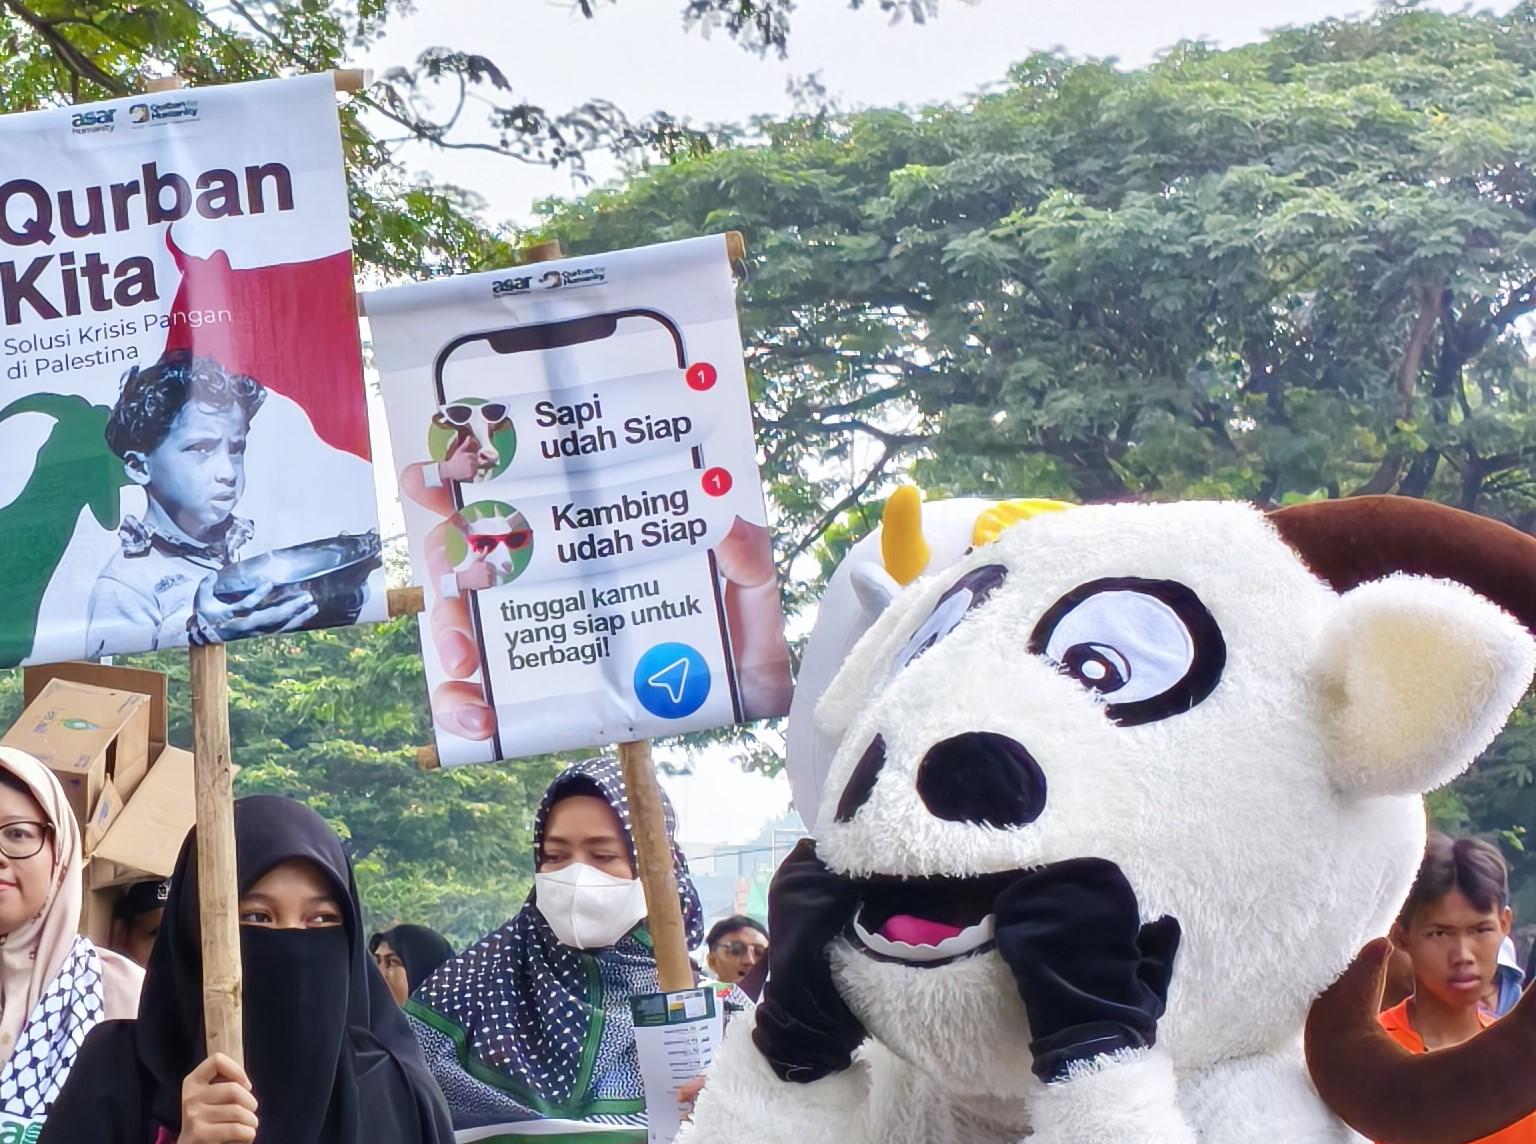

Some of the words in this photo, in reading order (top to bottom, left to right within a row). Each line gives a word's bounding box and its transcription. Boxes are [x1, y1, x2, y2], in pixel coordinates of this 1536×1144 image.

[71, 108, 117, 127] asar
[0, 251, 160, 326] Kita
[4, 329, 71, 356] Solusi
[78, 318, 137, 343] Krisis
[144, 307, 232, 334] Pangan
[7, 361, 29, 380] di
[36, 343, 139, 377] Palestina
[535, 393, 603, 434] Sapi
[540, 424, 616, 459] udah
[624, 414, 692, 445] Siap
[551, 488, 689, 531] Kambing
[557, 531, 634, 563] udah
[640, 516, 707, 548] Siap
[500, 589, 586, 623] tinggal
[592, 578, 660, 609] kamu
[505, 622, 566, 652] yang
[573, 611, 625, 637] siap
[631, 594, 703, 627] untuk
[508, 636, 611, 671] berbagi!
